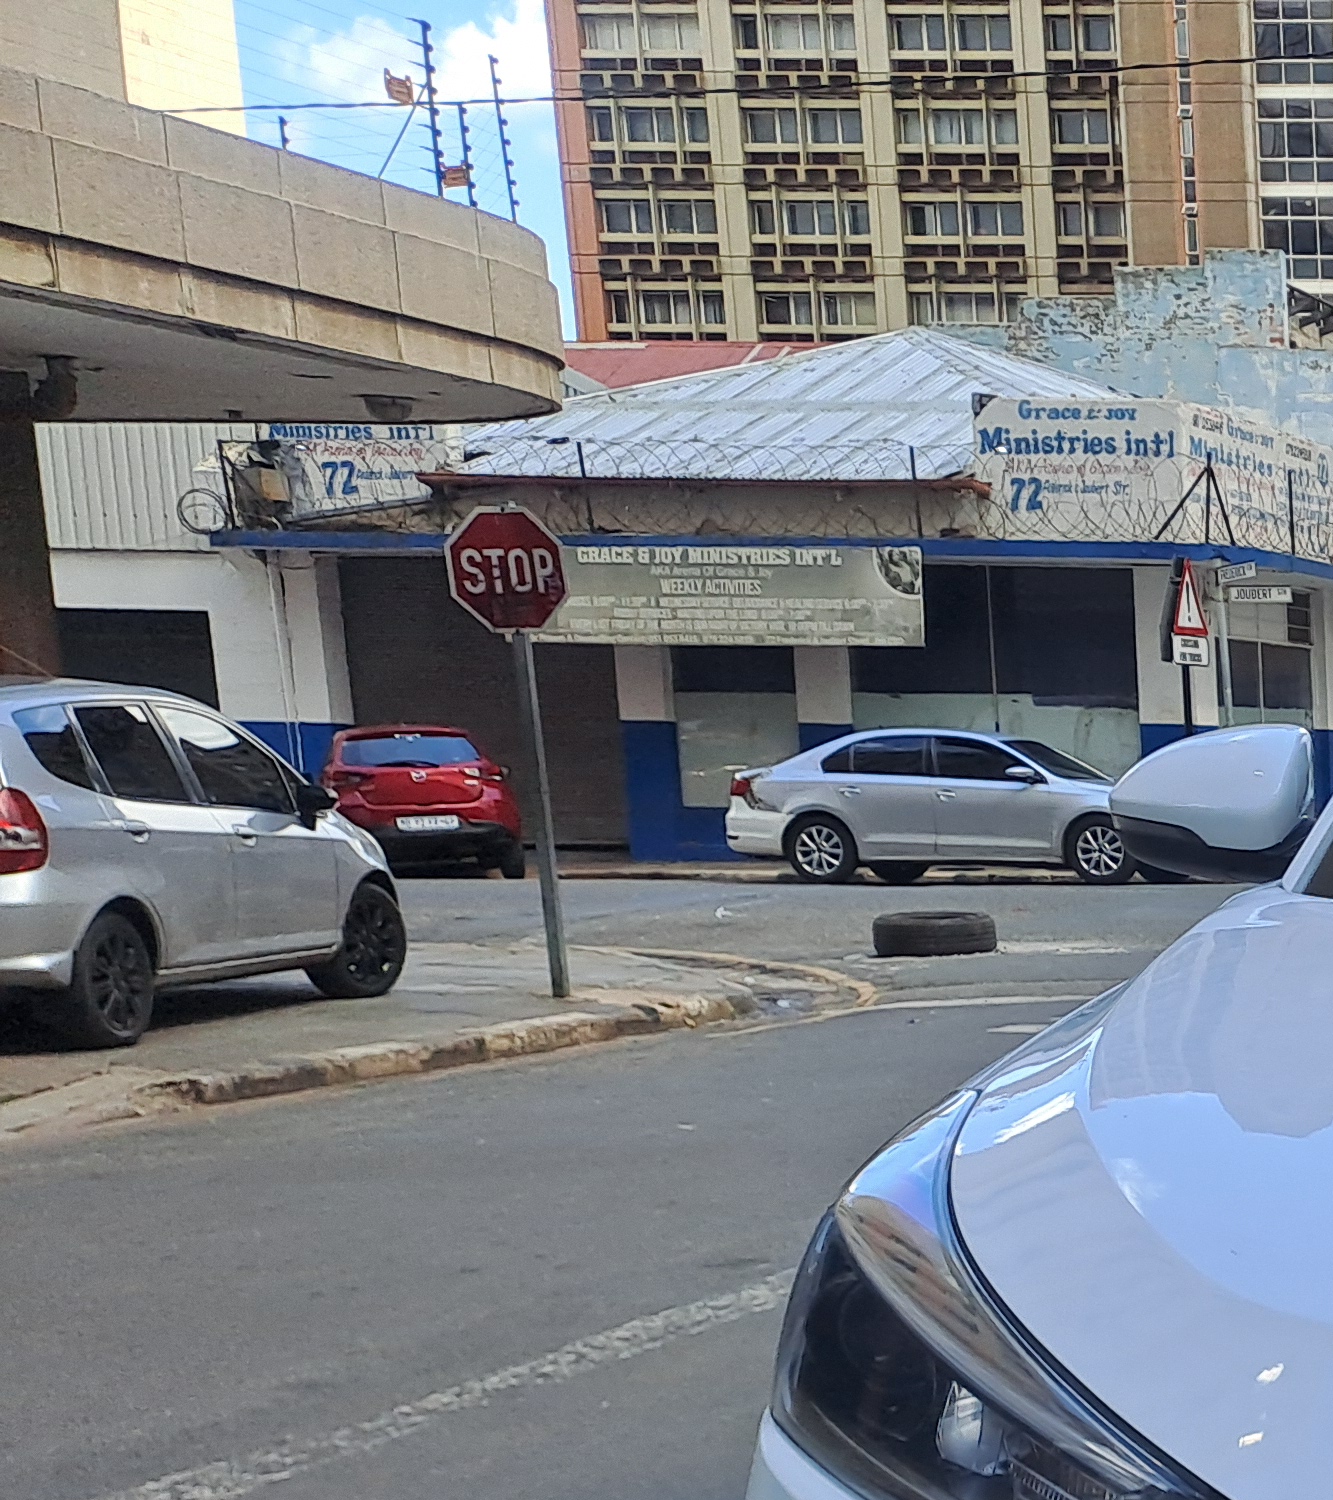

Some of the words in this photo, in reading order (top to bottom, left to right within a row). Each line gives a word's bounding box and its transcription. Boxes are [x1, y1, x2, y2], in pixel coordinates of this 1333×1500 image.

[1018, 400, 1081, 420] Grace
[978, 427, 1117, 455] Ministries
[1125, 429, 1174, 458] int'l
[1189, 435, 1273, 477] Ministries
[321, 460, 359, 496] 72
[1010, 477, 1043, 513] 72
[460, 548, 554, 594] STOP
[577, 546, 634, 564] GRACE
[637, 547, 650, 564] &
[653, 547, 683, 564] JOY
[687, 547, 791, 566] MINISTRIES
[795, 548, 842, 566] INT'L
[660, 579, 702, 595] WEEKLY
[705, 580, 762, 596] ACTIVITIES
